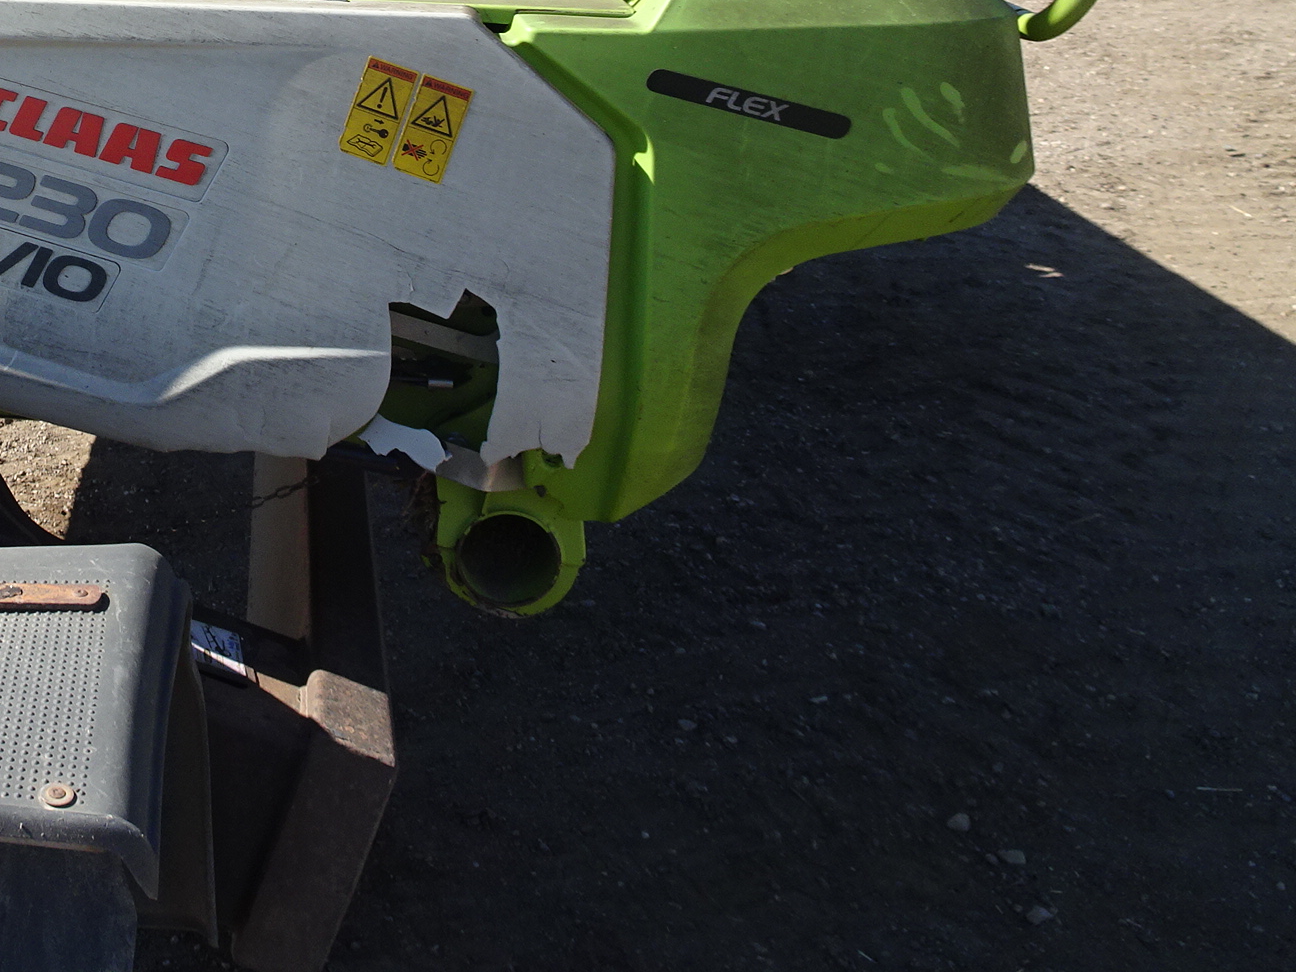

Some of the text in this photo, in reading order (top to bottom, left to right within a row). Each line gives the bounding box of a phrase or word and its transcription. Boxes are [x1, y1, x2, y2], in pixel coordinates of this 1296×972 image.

[380, 63, 413, 80] WARNING
[433, 82, 470, 99] WARNING
[705, 87, 789, 121] FLEX
